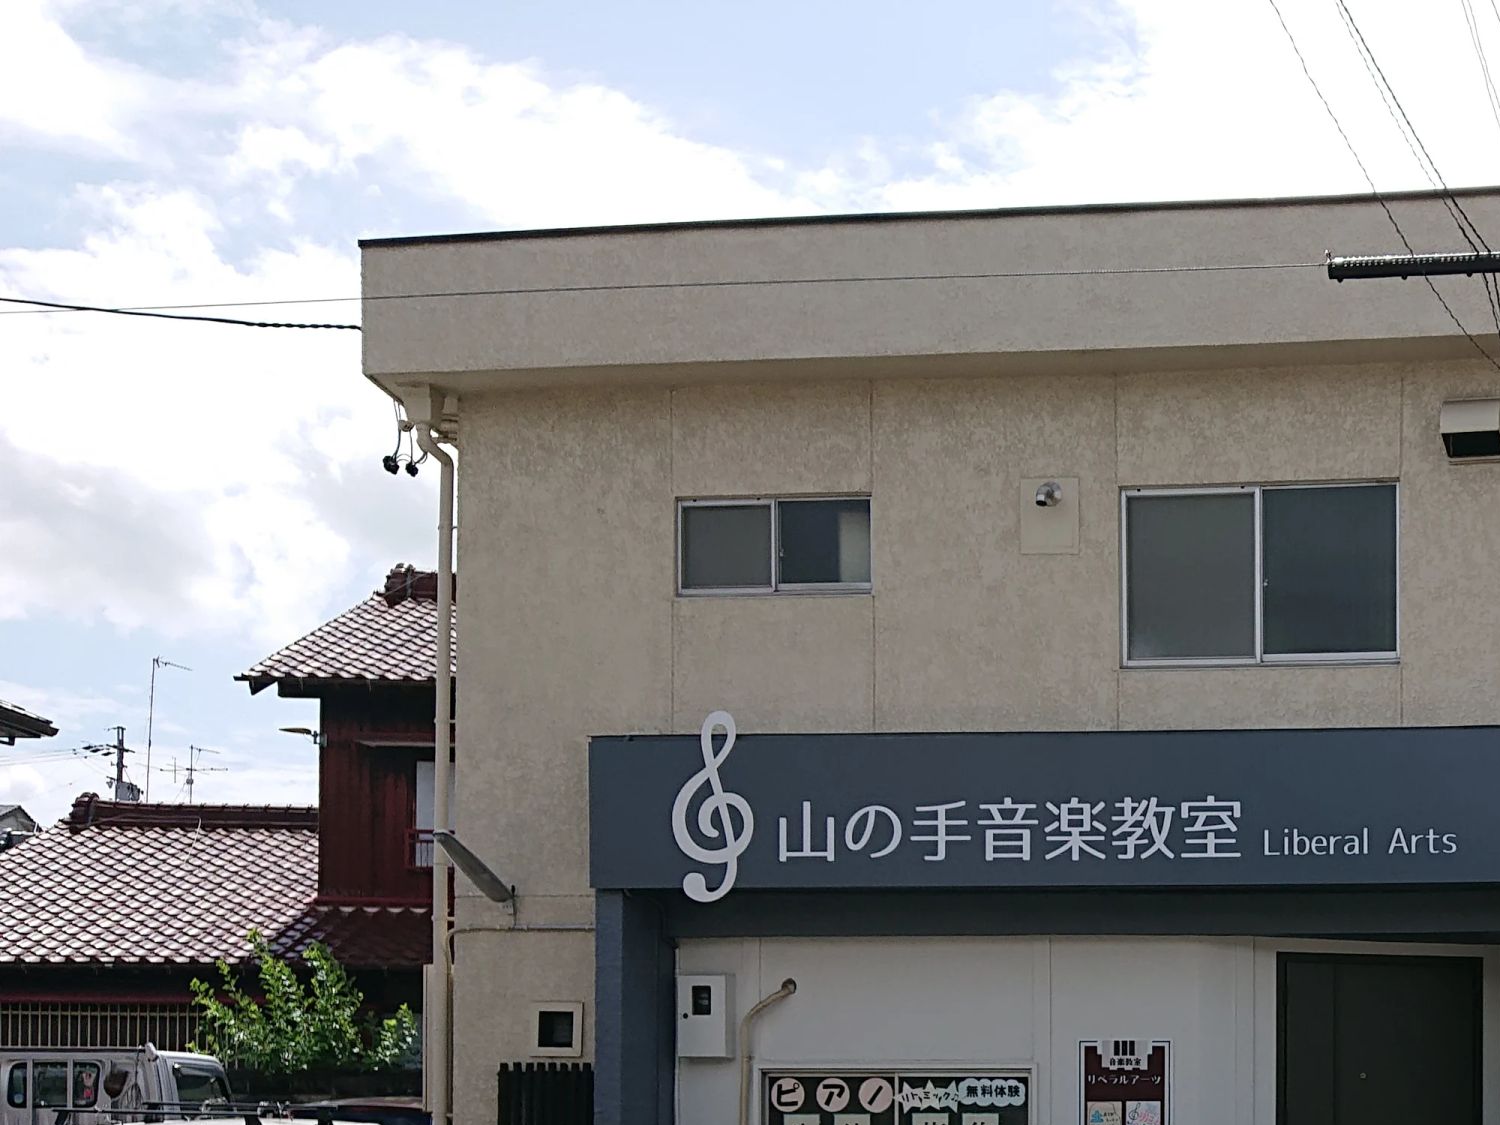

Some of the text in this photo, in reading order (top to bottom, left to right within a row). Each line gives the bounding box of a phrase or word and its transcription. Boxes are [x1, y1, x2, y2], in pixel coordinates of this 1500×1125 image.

[777, 796, 1457, 863] 山の手音楽教室 Liberal Arts
[776, 1083, 883, 1107] ピアノ
[966, 1084, 1021, 1098] 無料体験
